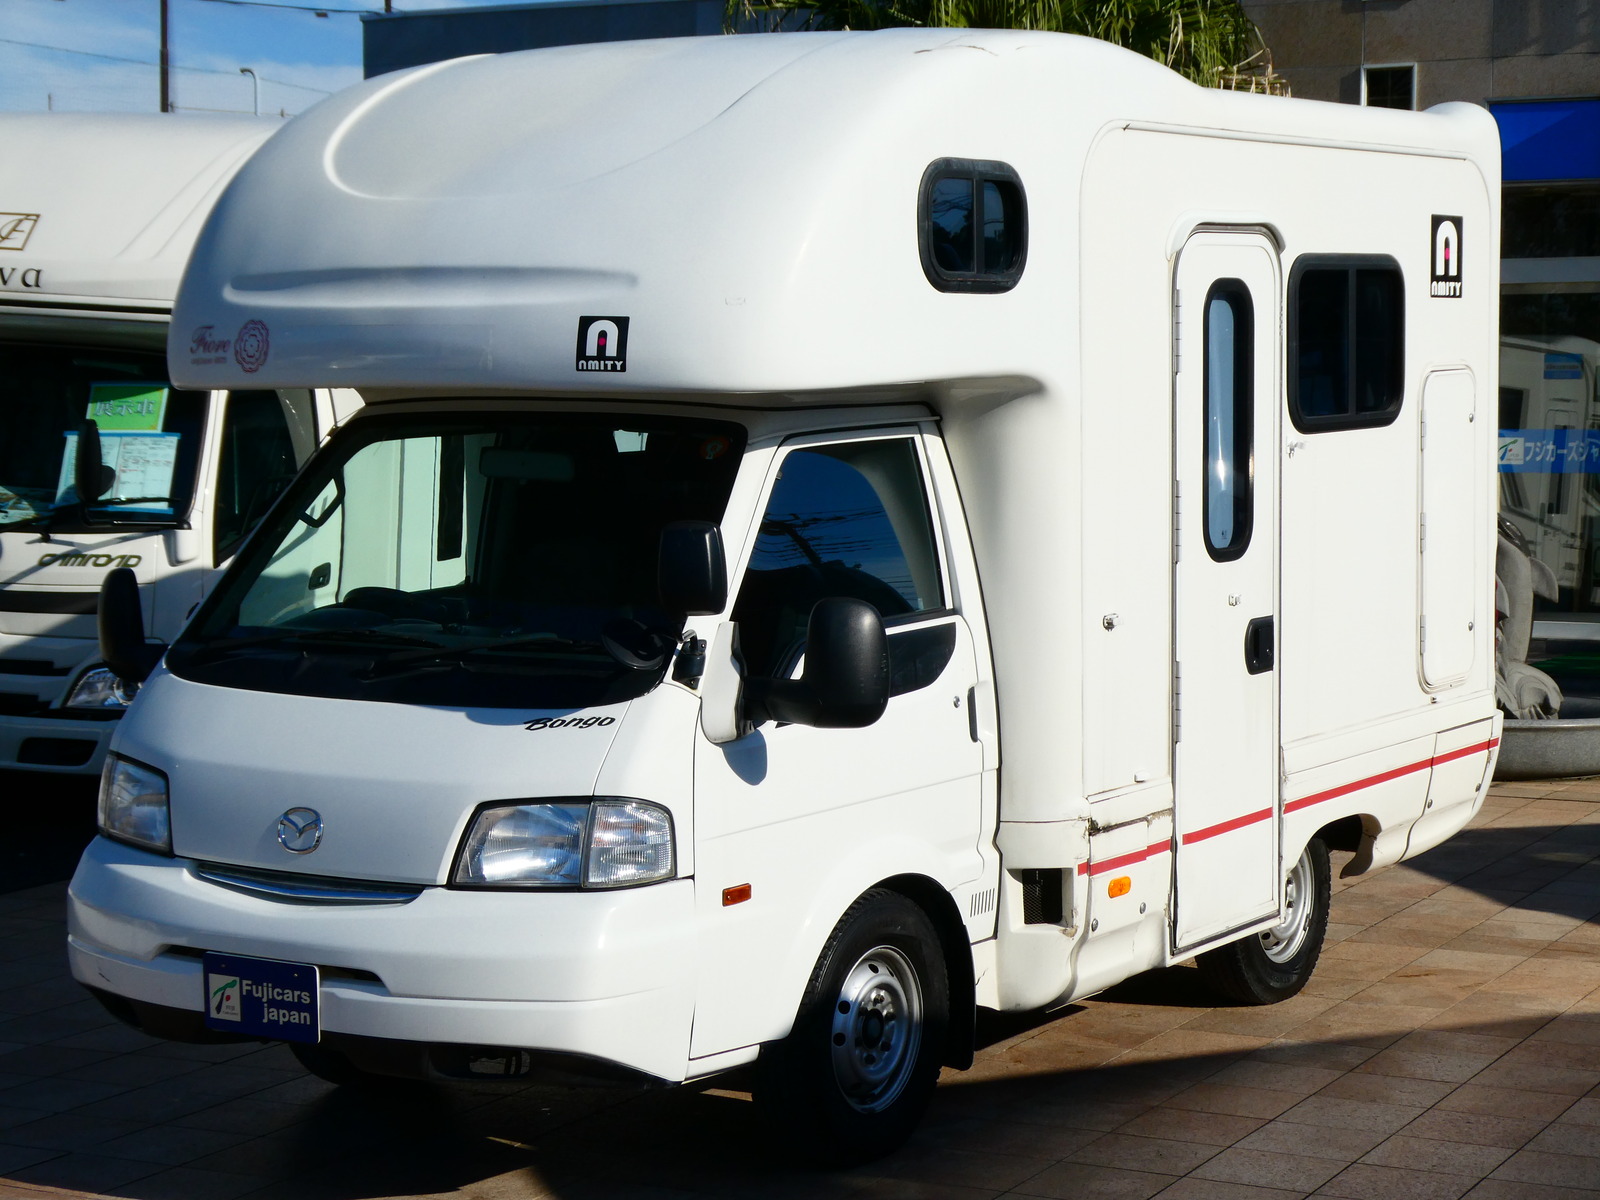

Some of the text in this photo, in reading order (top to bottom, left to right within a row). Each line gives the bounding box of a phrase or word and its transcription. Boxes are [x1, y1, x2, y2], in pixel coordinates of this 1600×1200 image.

[523, 716, 616, 731] Bongo
[241, 979, 311, 1004] Fujicars
[262, 1003, 311, 1025] japan
